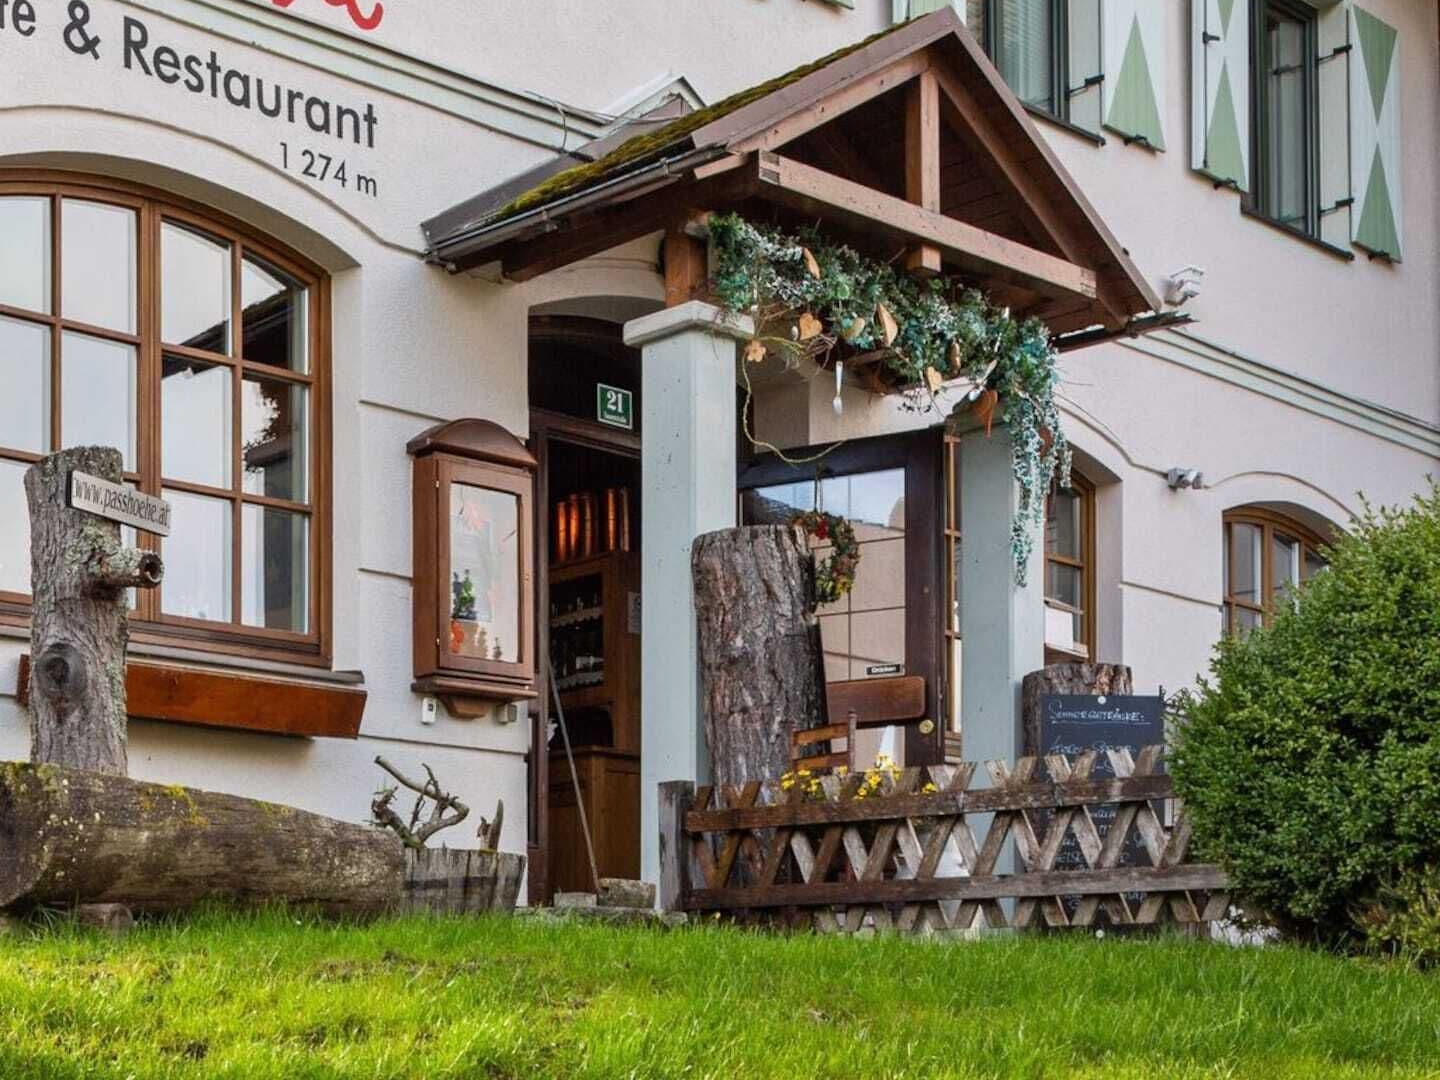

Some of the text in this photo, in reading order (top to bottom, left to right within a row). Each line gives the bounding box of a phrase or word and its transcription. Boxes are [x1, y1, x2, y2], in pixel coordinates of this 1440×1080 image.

[63, 0, 101, 60] &
[123, 16, 378, 149] Restaurant
[357, 172, 378, 198] m
[606, 390, 624, 413] 21
[73, 477, 171, 527] www.passhoehe.at
